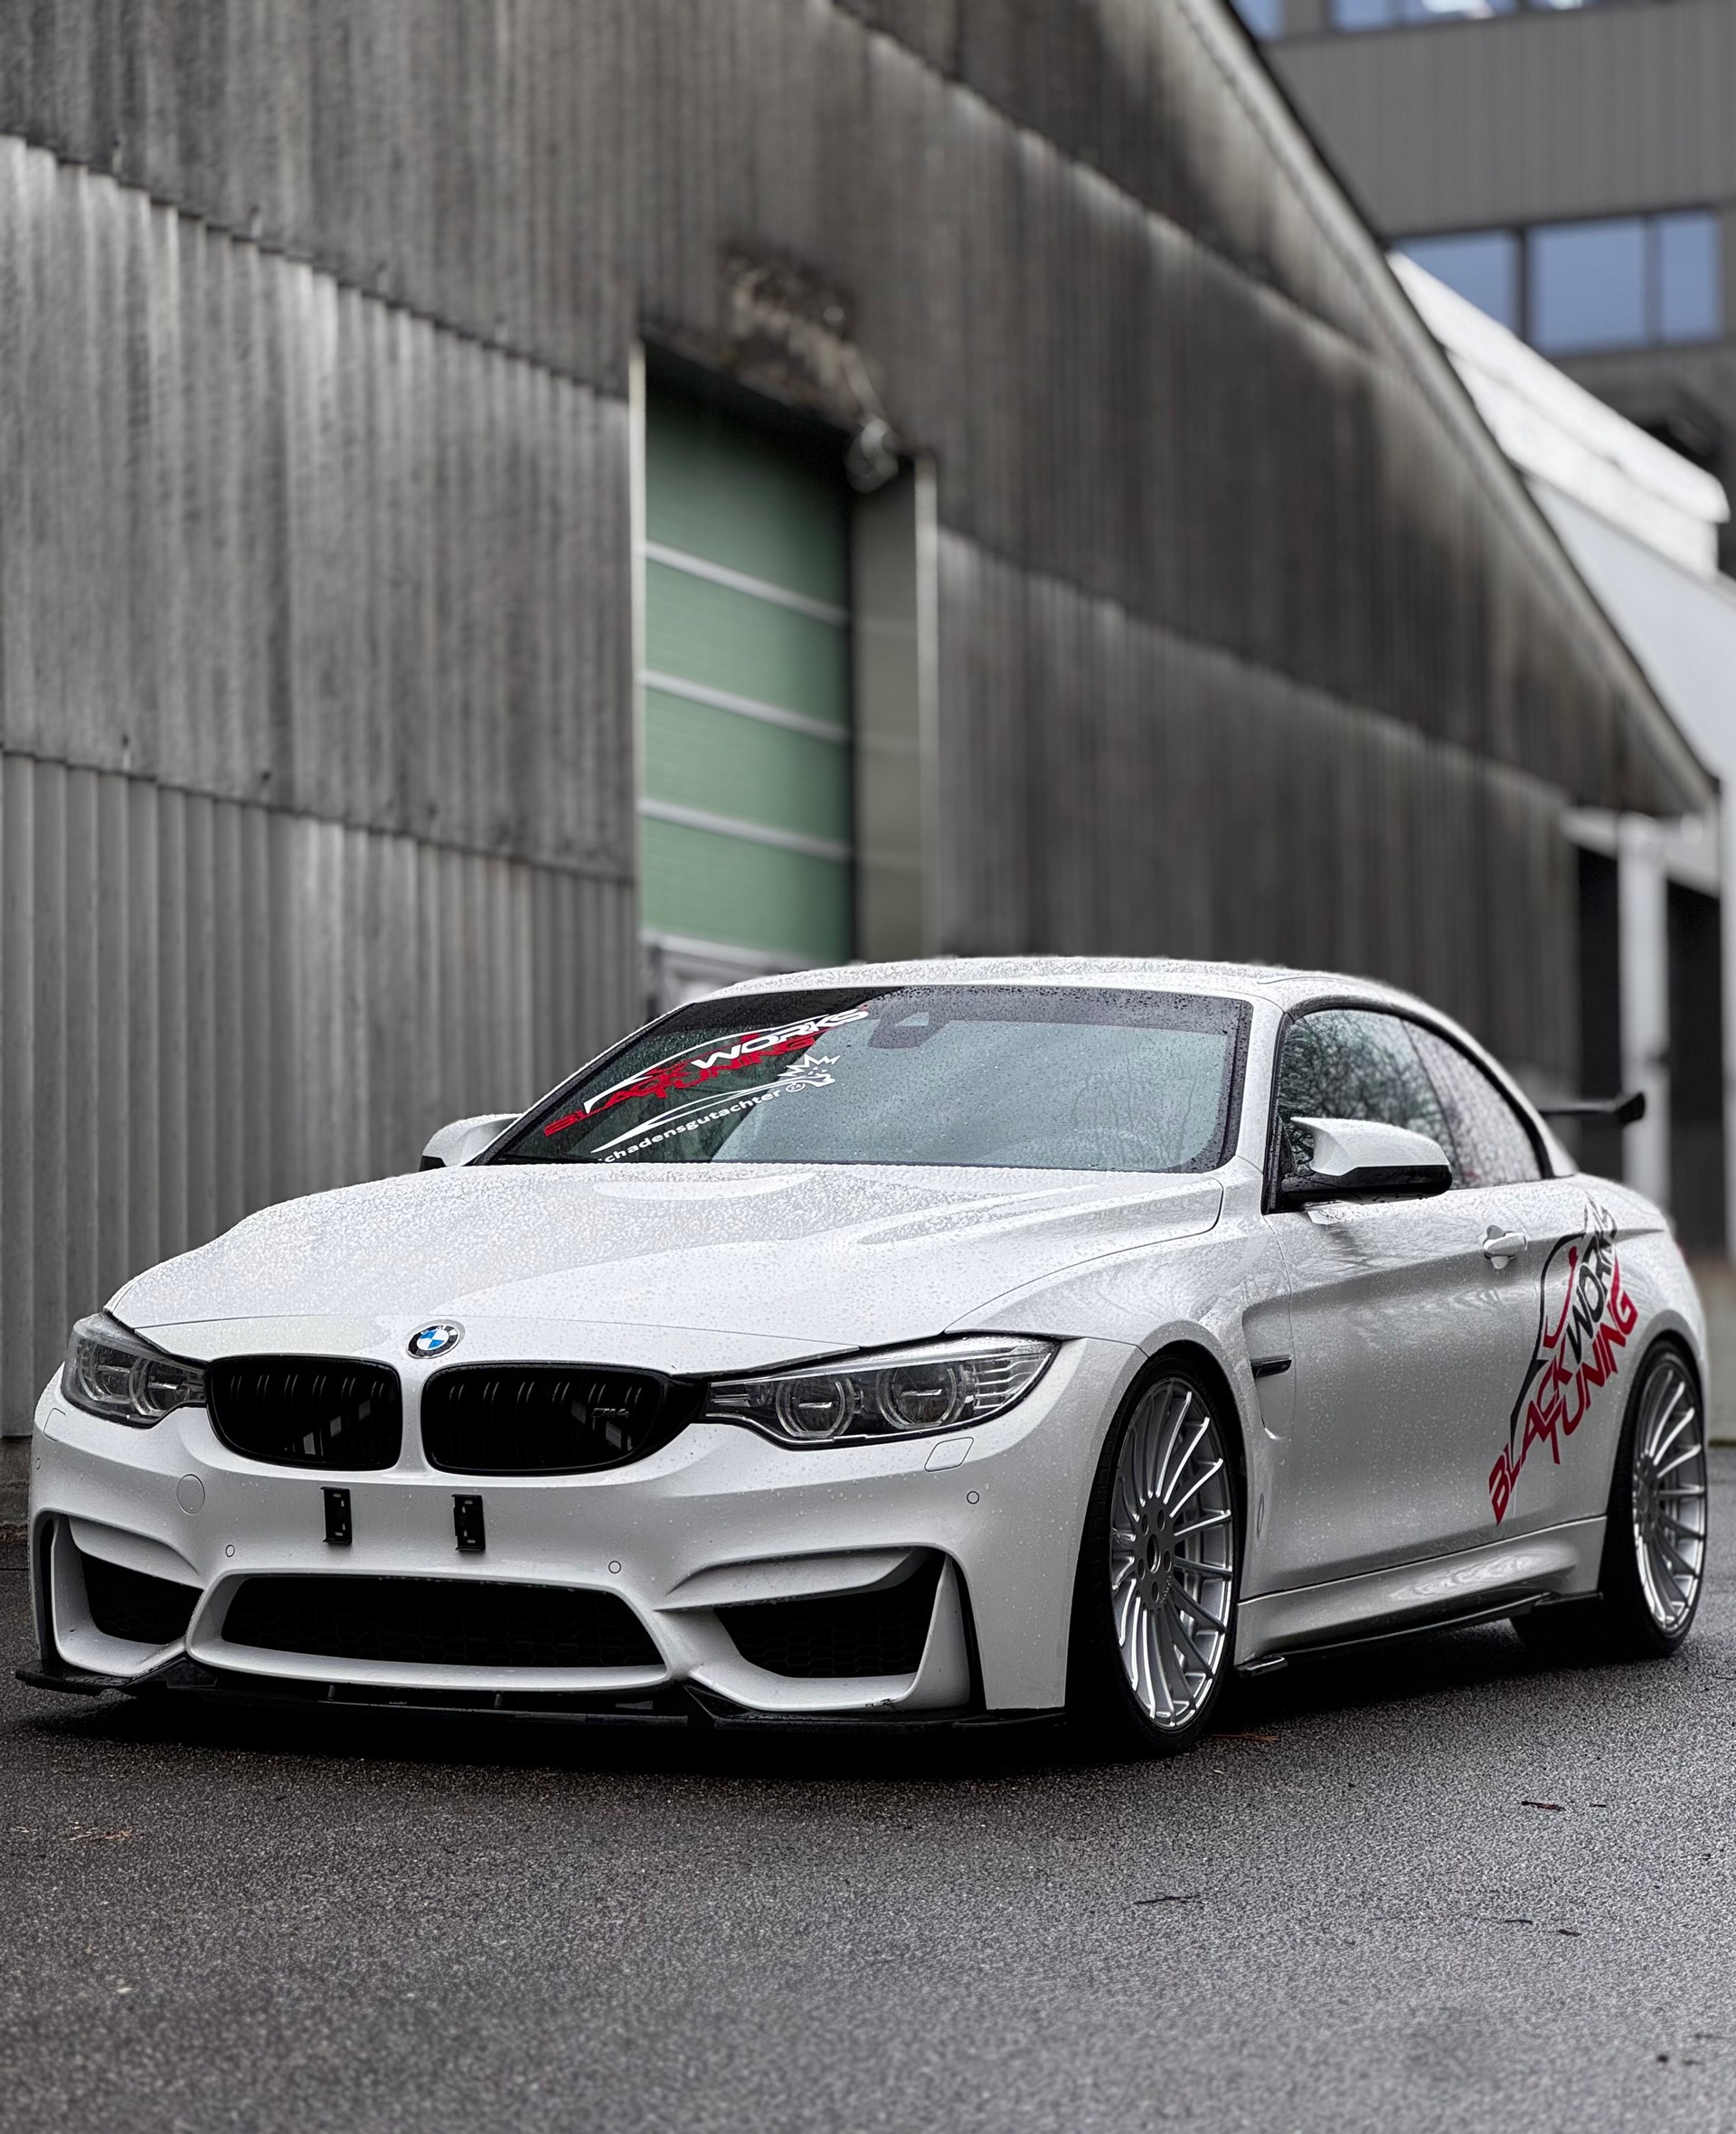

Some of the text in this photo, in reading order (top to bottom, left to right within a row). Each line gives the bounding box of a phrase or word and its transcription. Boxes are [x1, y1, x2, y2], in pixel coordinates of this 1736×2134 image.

[544, 1008, 869, 1137] BLACK WORKS
[599, 1090, 782, 1163] chadensgutachter
[638, 1031, 823, 1099] TUNING
[1539, 1249, 1638, 1465] TUNING
[1489, 1335, 1573, 1526] BLACK
